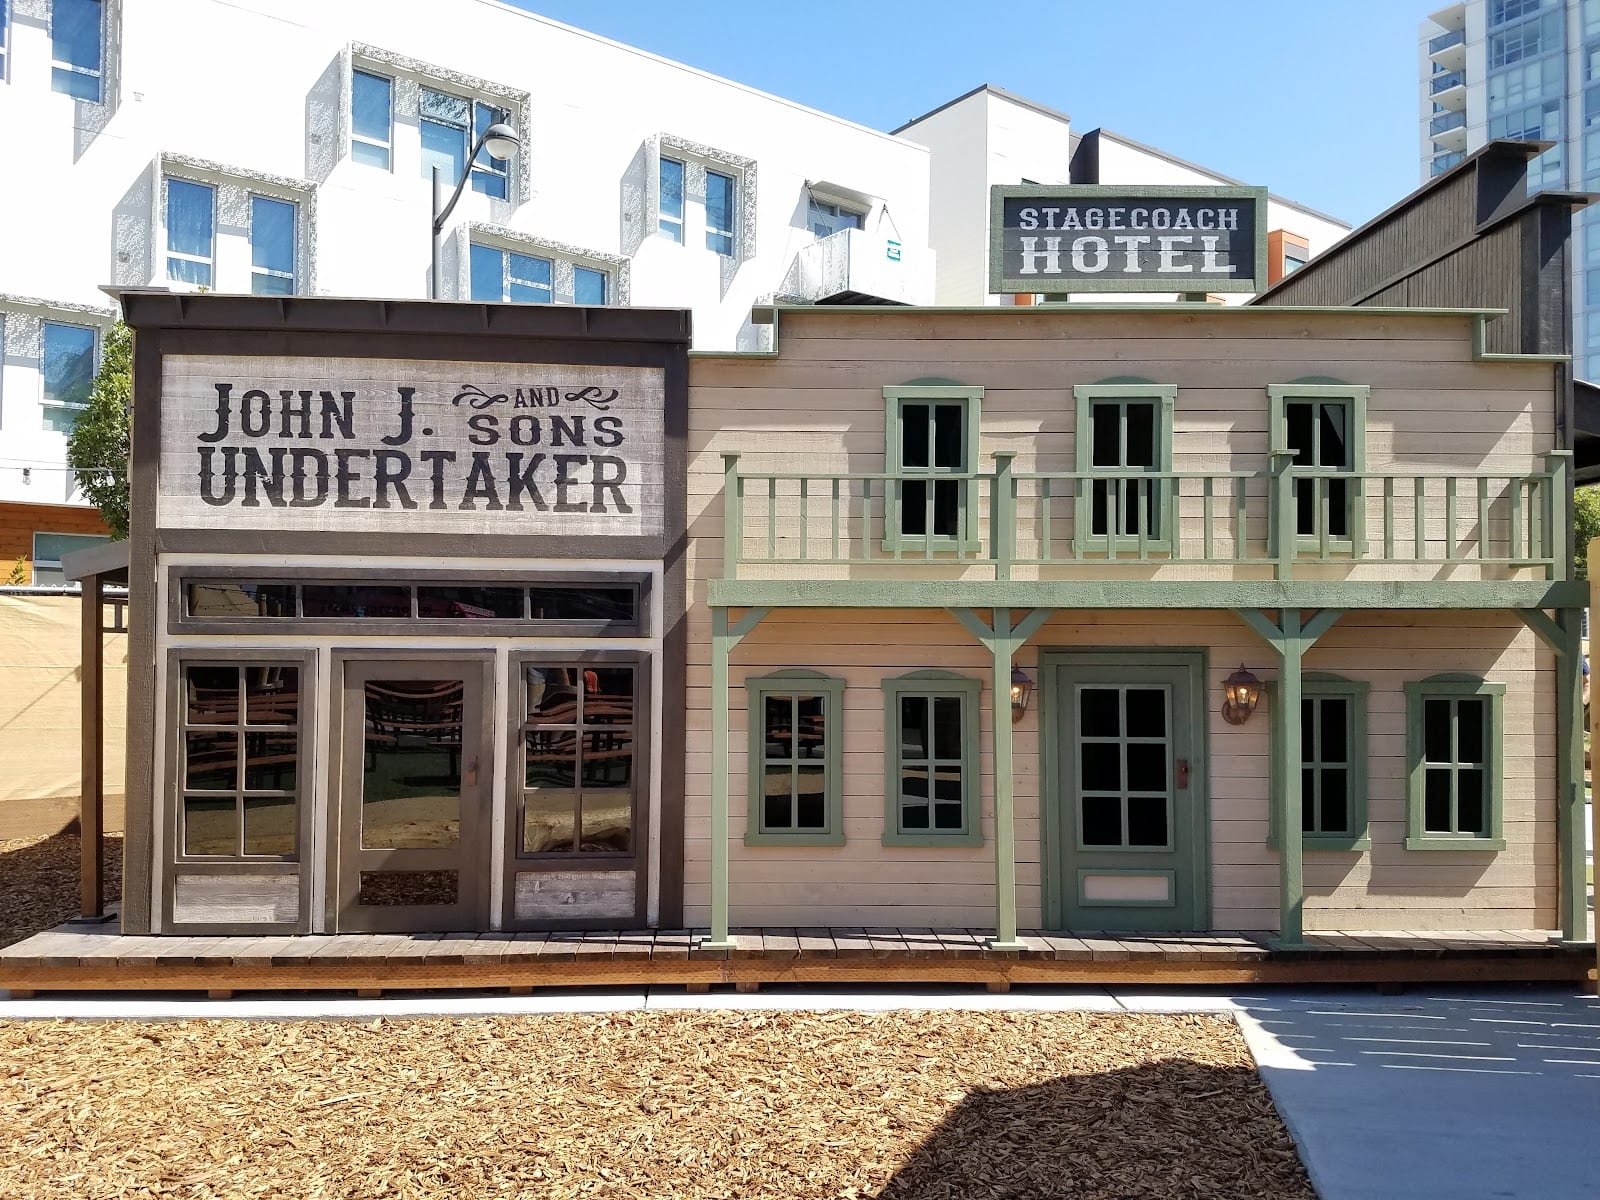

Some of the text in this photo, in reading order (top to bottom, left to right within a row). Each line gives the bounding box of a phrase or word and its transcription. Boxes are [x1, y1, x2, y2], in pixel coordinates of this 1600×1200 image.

[1019, 207, 1238, 231] STAGECOACH
[1019, 235, 1237, 274] HOTEL
[197, 383, 433, 444] JOHN J.
[514, 386, 561, 409] AND
[468, 414, 626, 448] SONS
[197, 446, 634, 514] UNDERTAKER
